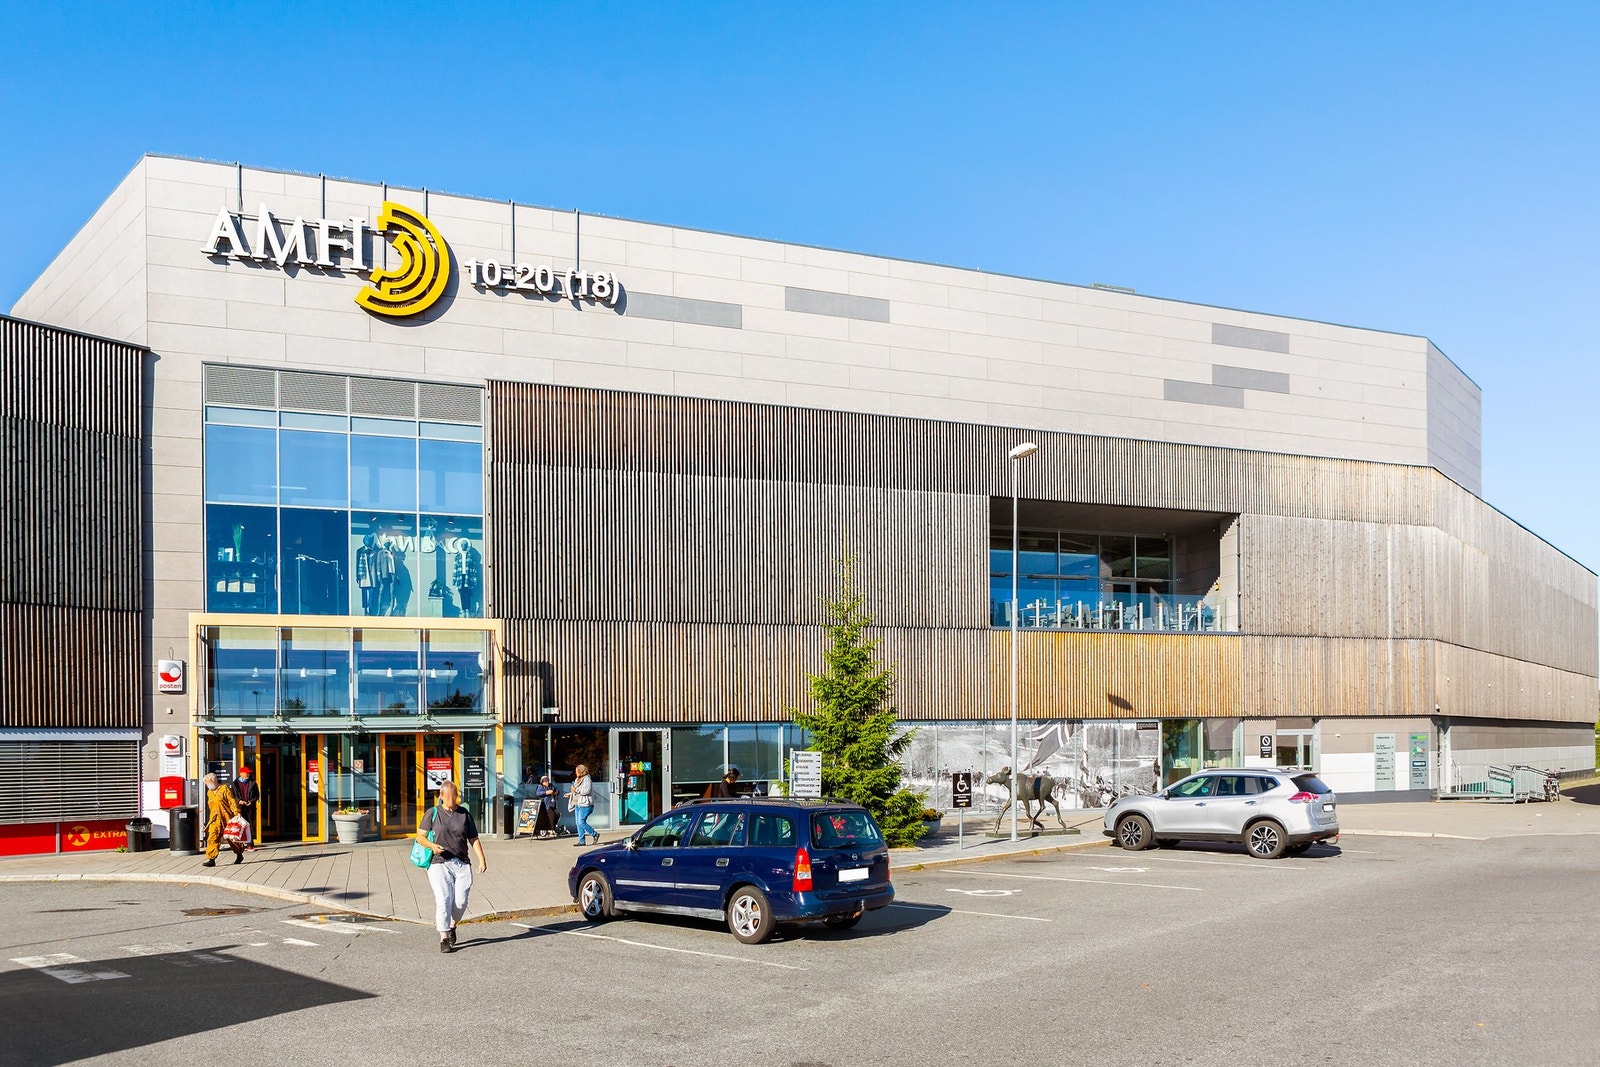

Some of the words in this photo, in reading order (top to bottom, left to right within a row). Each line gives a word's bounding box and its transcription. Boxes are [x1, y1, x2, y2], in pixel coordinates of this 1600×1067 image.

[200, 202, 368, 271] AMFI
[464, 255, 555, 292] 10-20
[564, 266, 620, 305] (18)
[159, 682, 182, 690] posten
[93, 830, 127, 839] EXTRA
